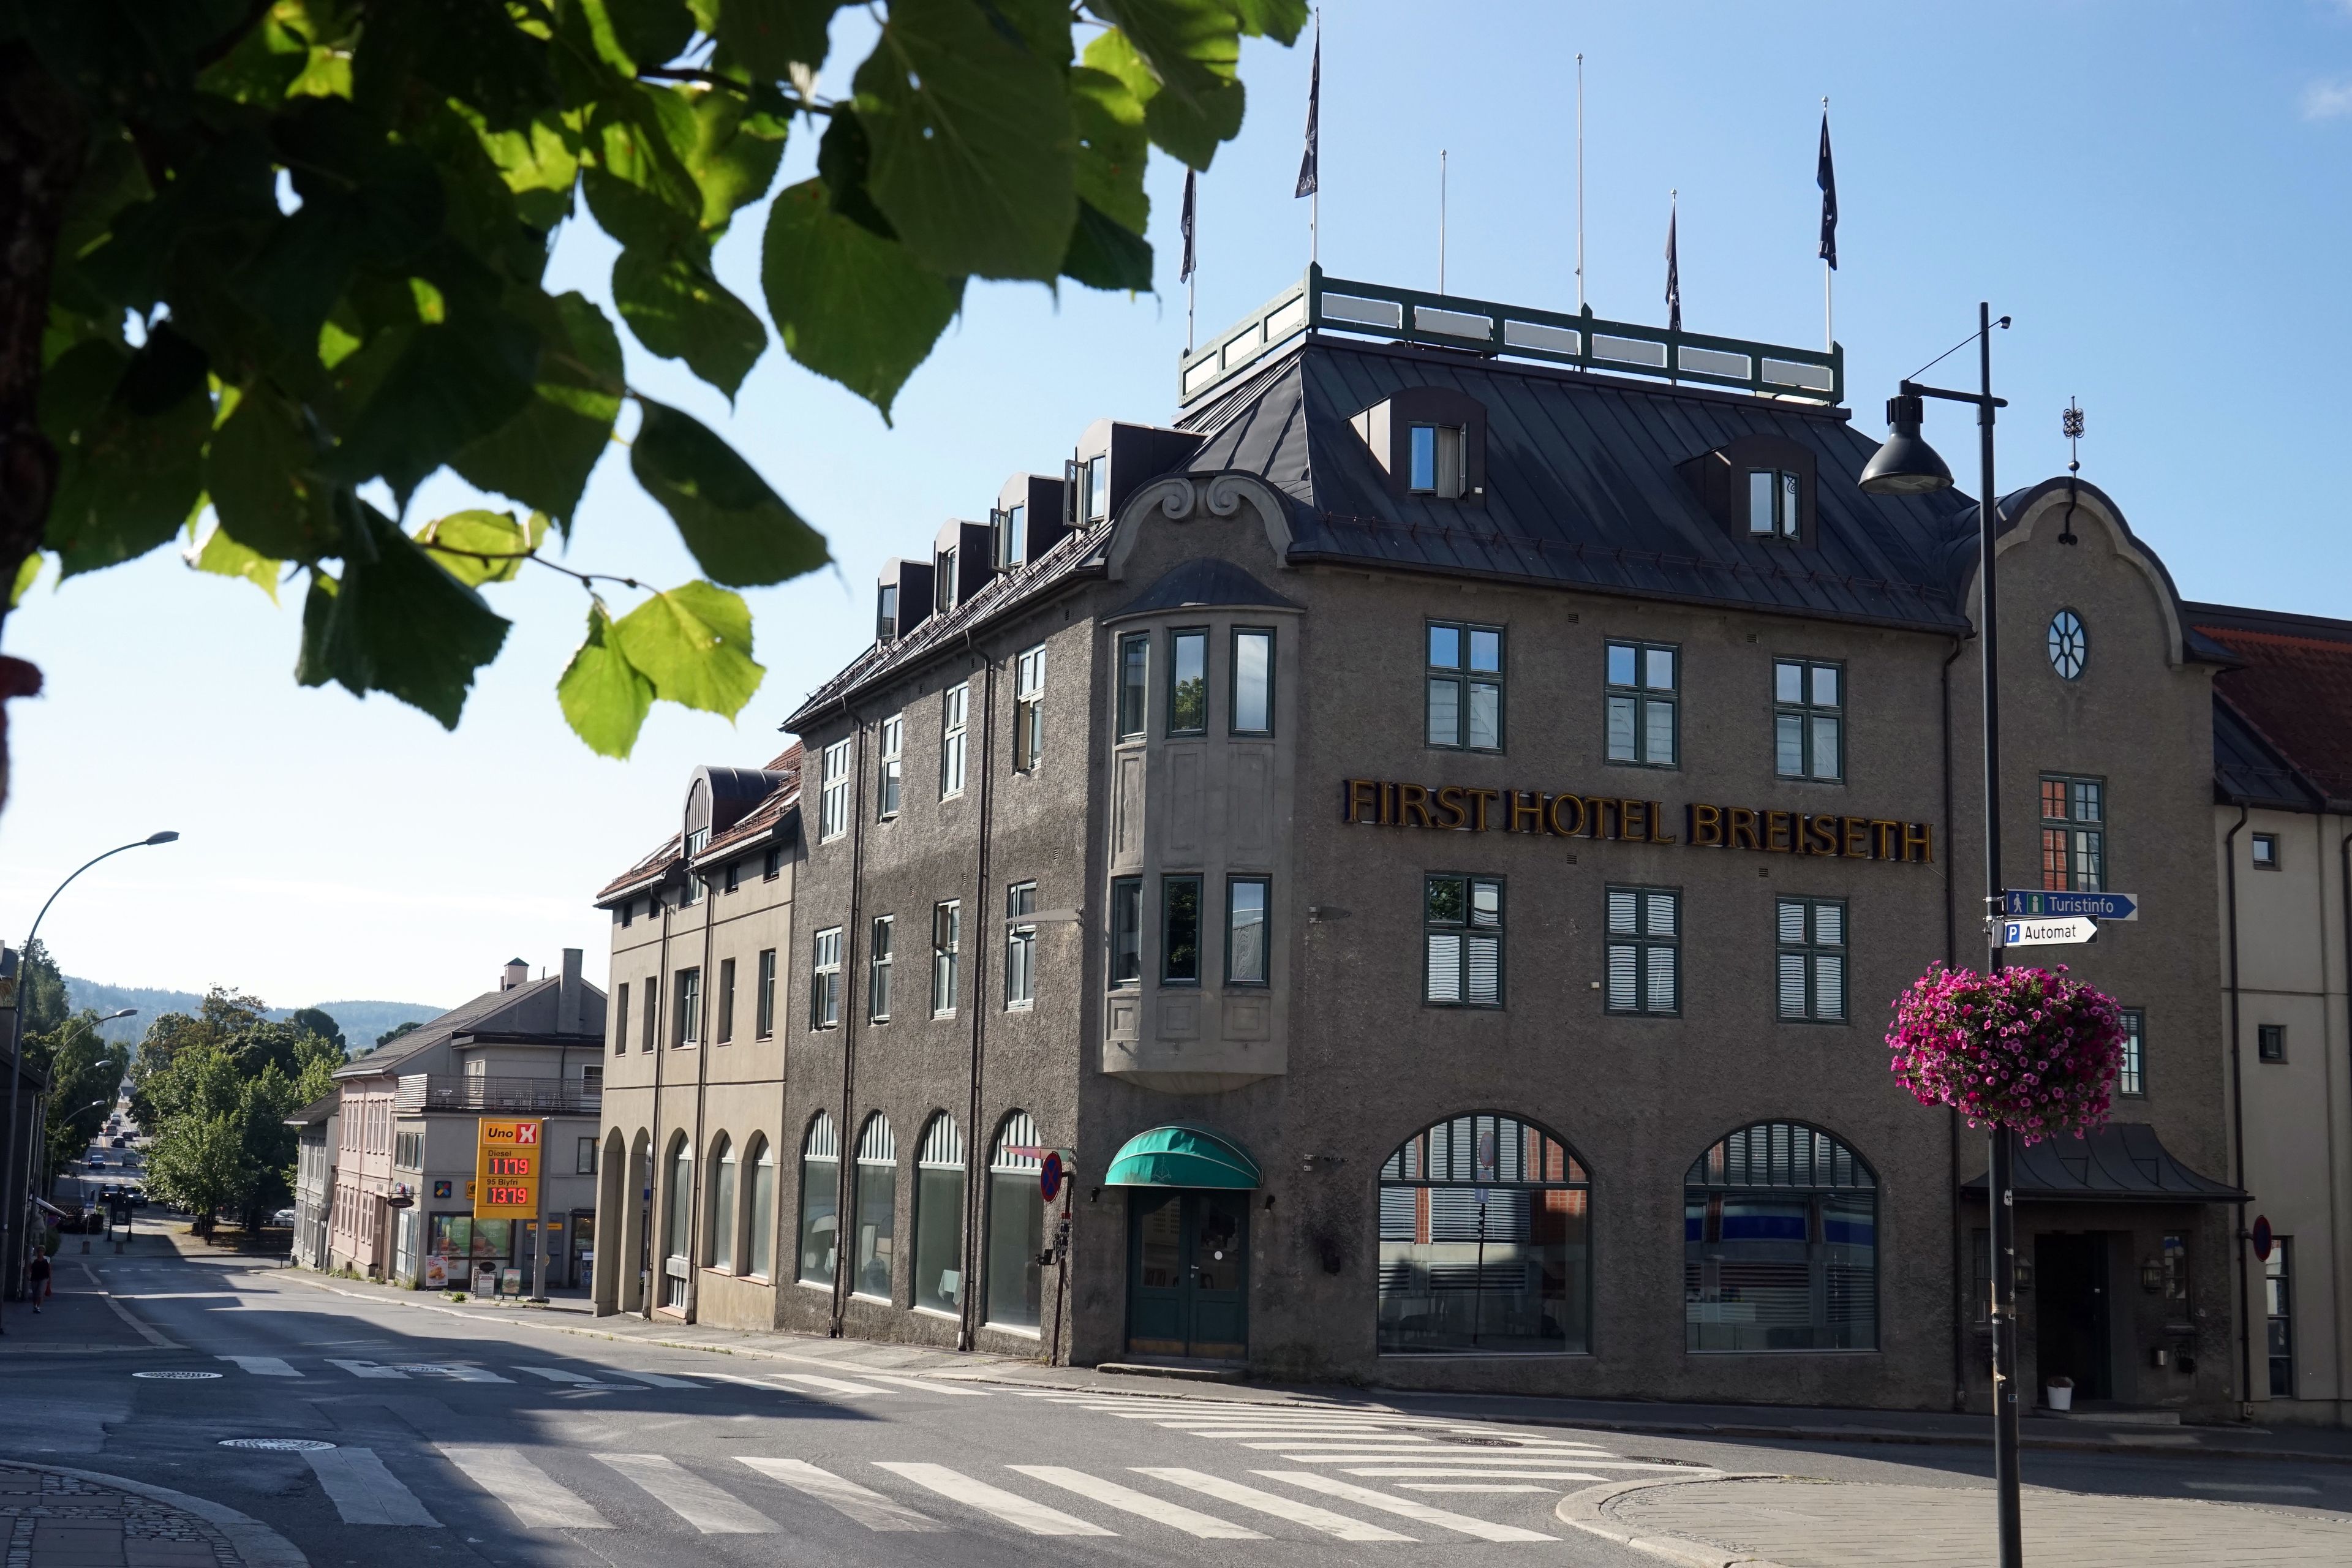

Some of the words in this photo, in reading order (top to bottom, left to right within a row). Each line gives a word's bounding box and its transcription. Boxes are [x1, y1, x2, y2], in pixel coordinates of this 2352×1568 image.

[1343, 778, 1499, 832] FIRST
[1504, 789, 1676, 844] HOTEL
[1686, 803, 1934, 864] BREISETH
[2049, 896, 2114, 913] Turistinfo
[2025, 924, 2076, 940] Automat
[488, 1128, 513, 1137] Uno
[519, 1125, 536, 1142] X
